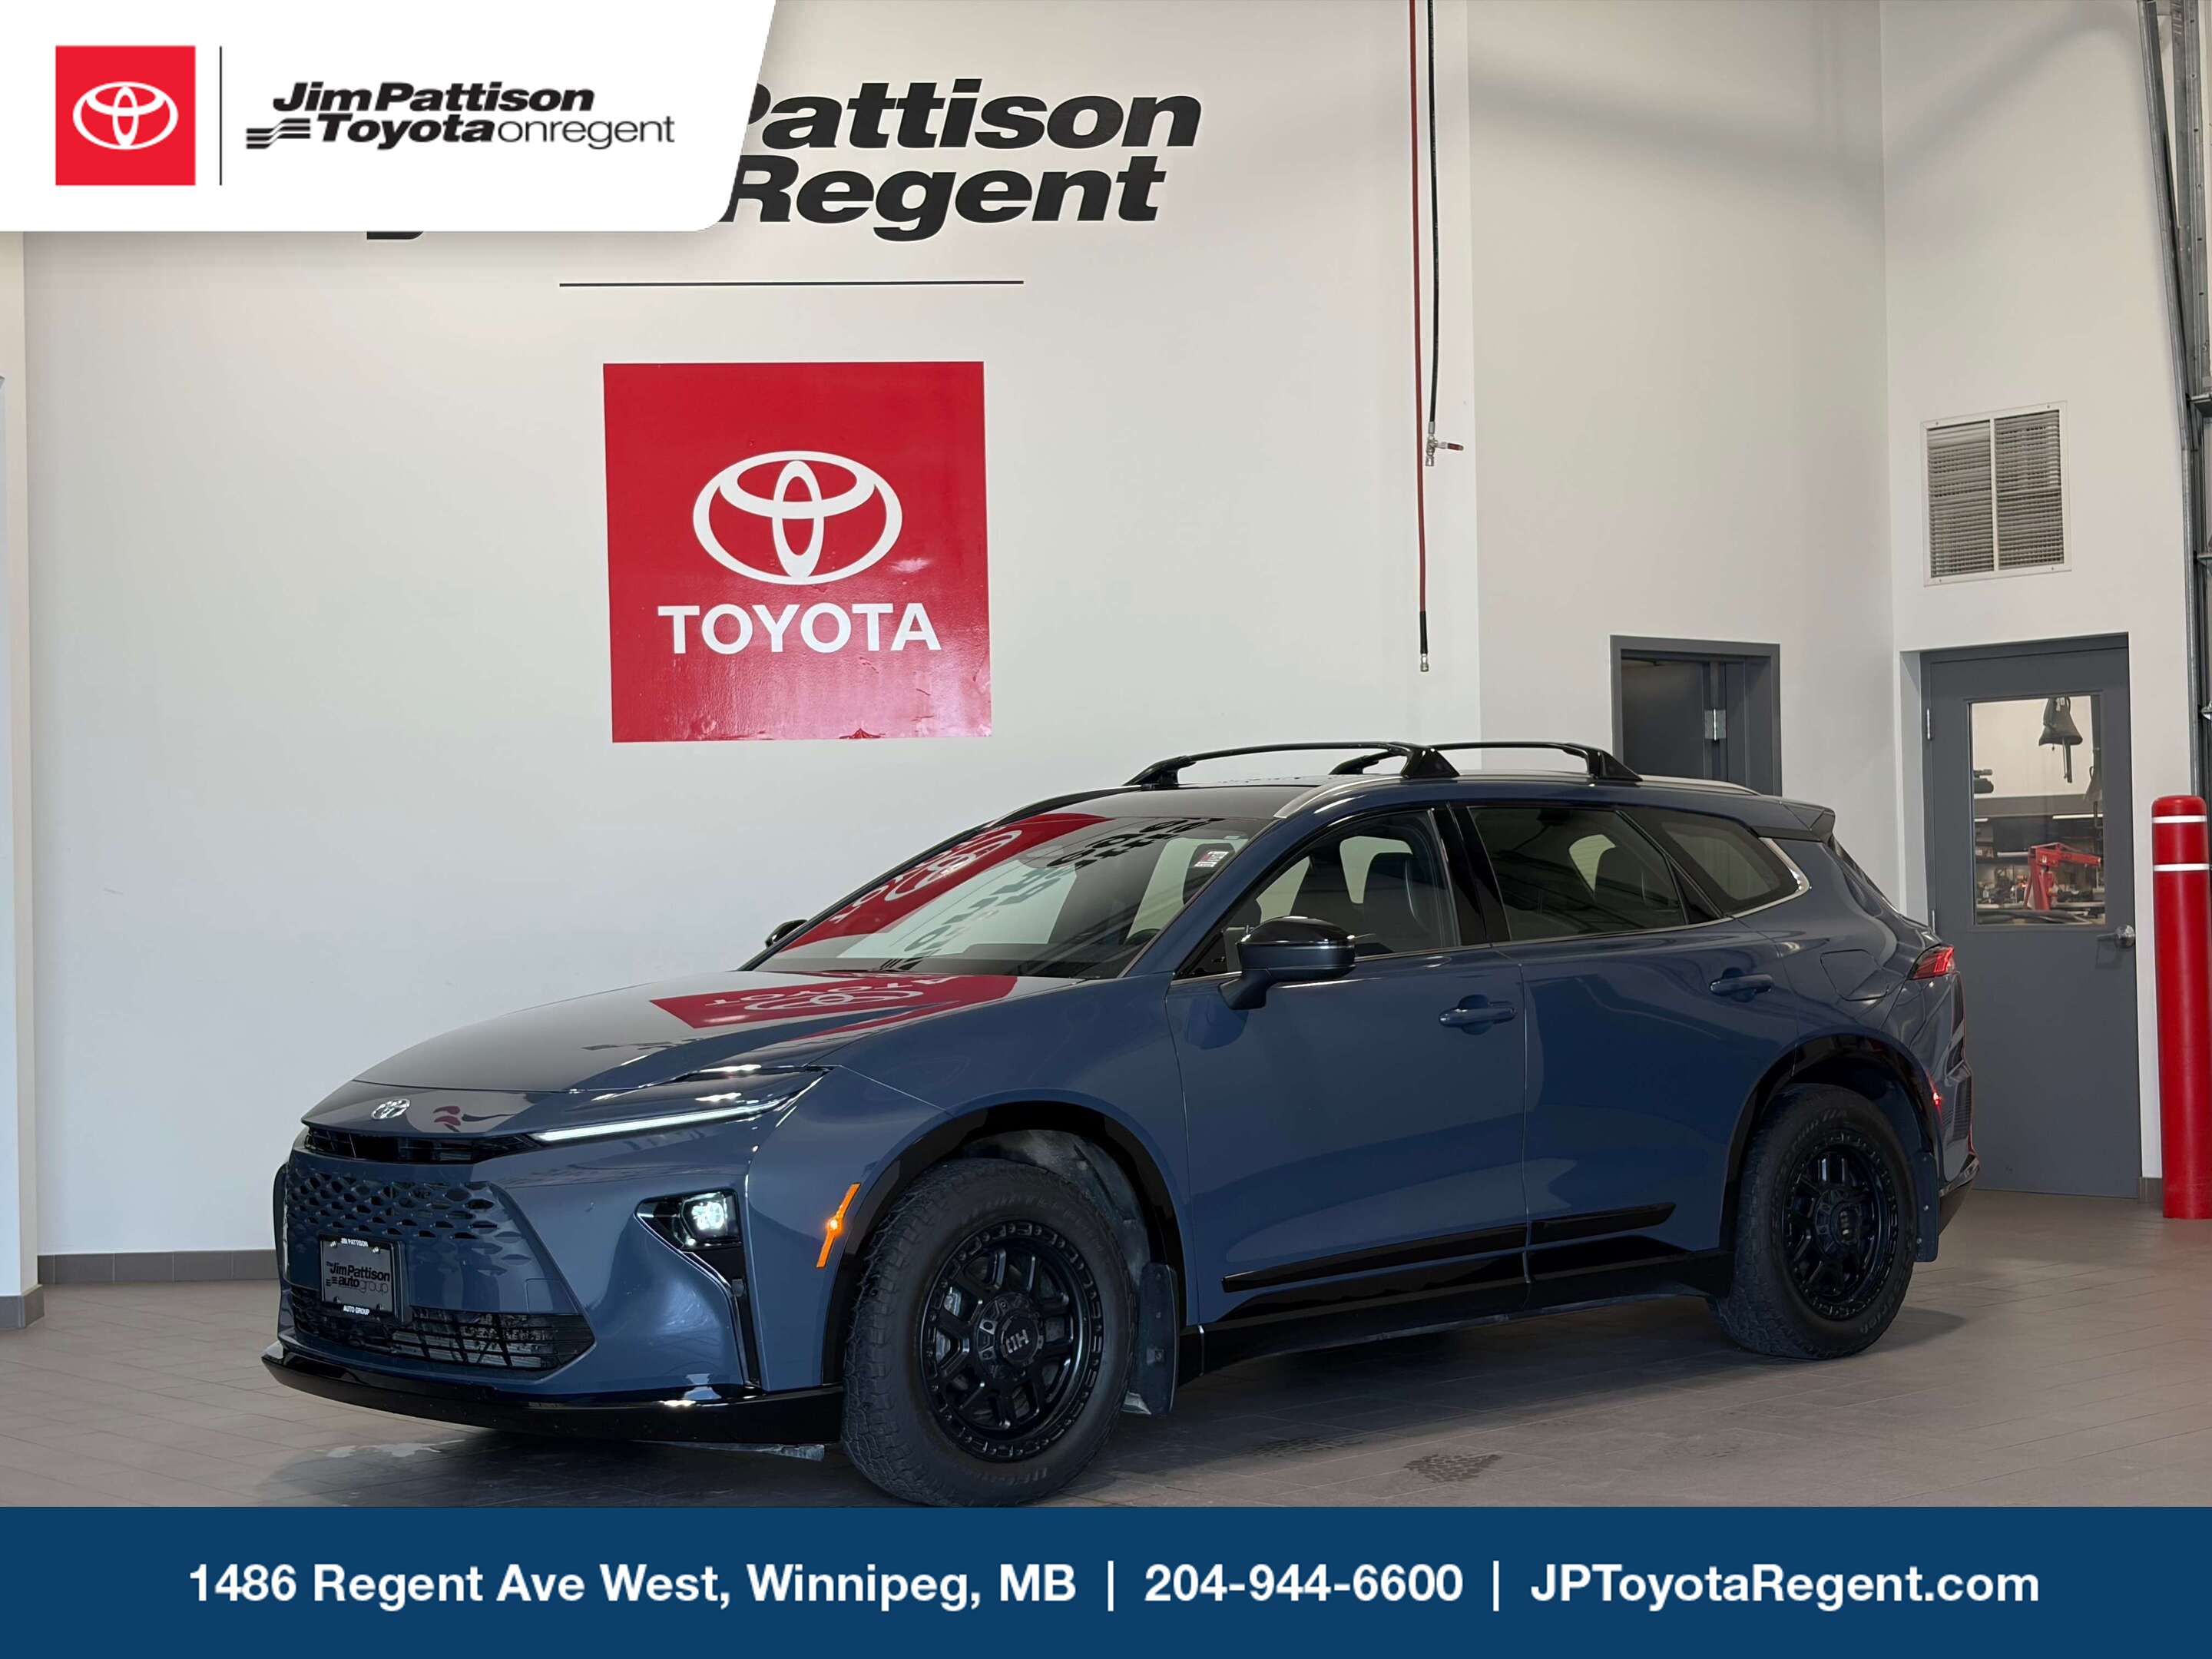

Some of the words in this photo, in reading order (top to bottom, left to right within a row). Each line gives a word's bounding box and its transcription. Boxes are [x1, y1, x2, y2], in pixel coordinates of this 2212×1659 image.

[721, 155, 1167, 242] Regent
[657, 602, 942, 654] TOYOTA
[343, 1305, 355, 1313] AUTO
[355, 1306, 370, 1316] GROUP
